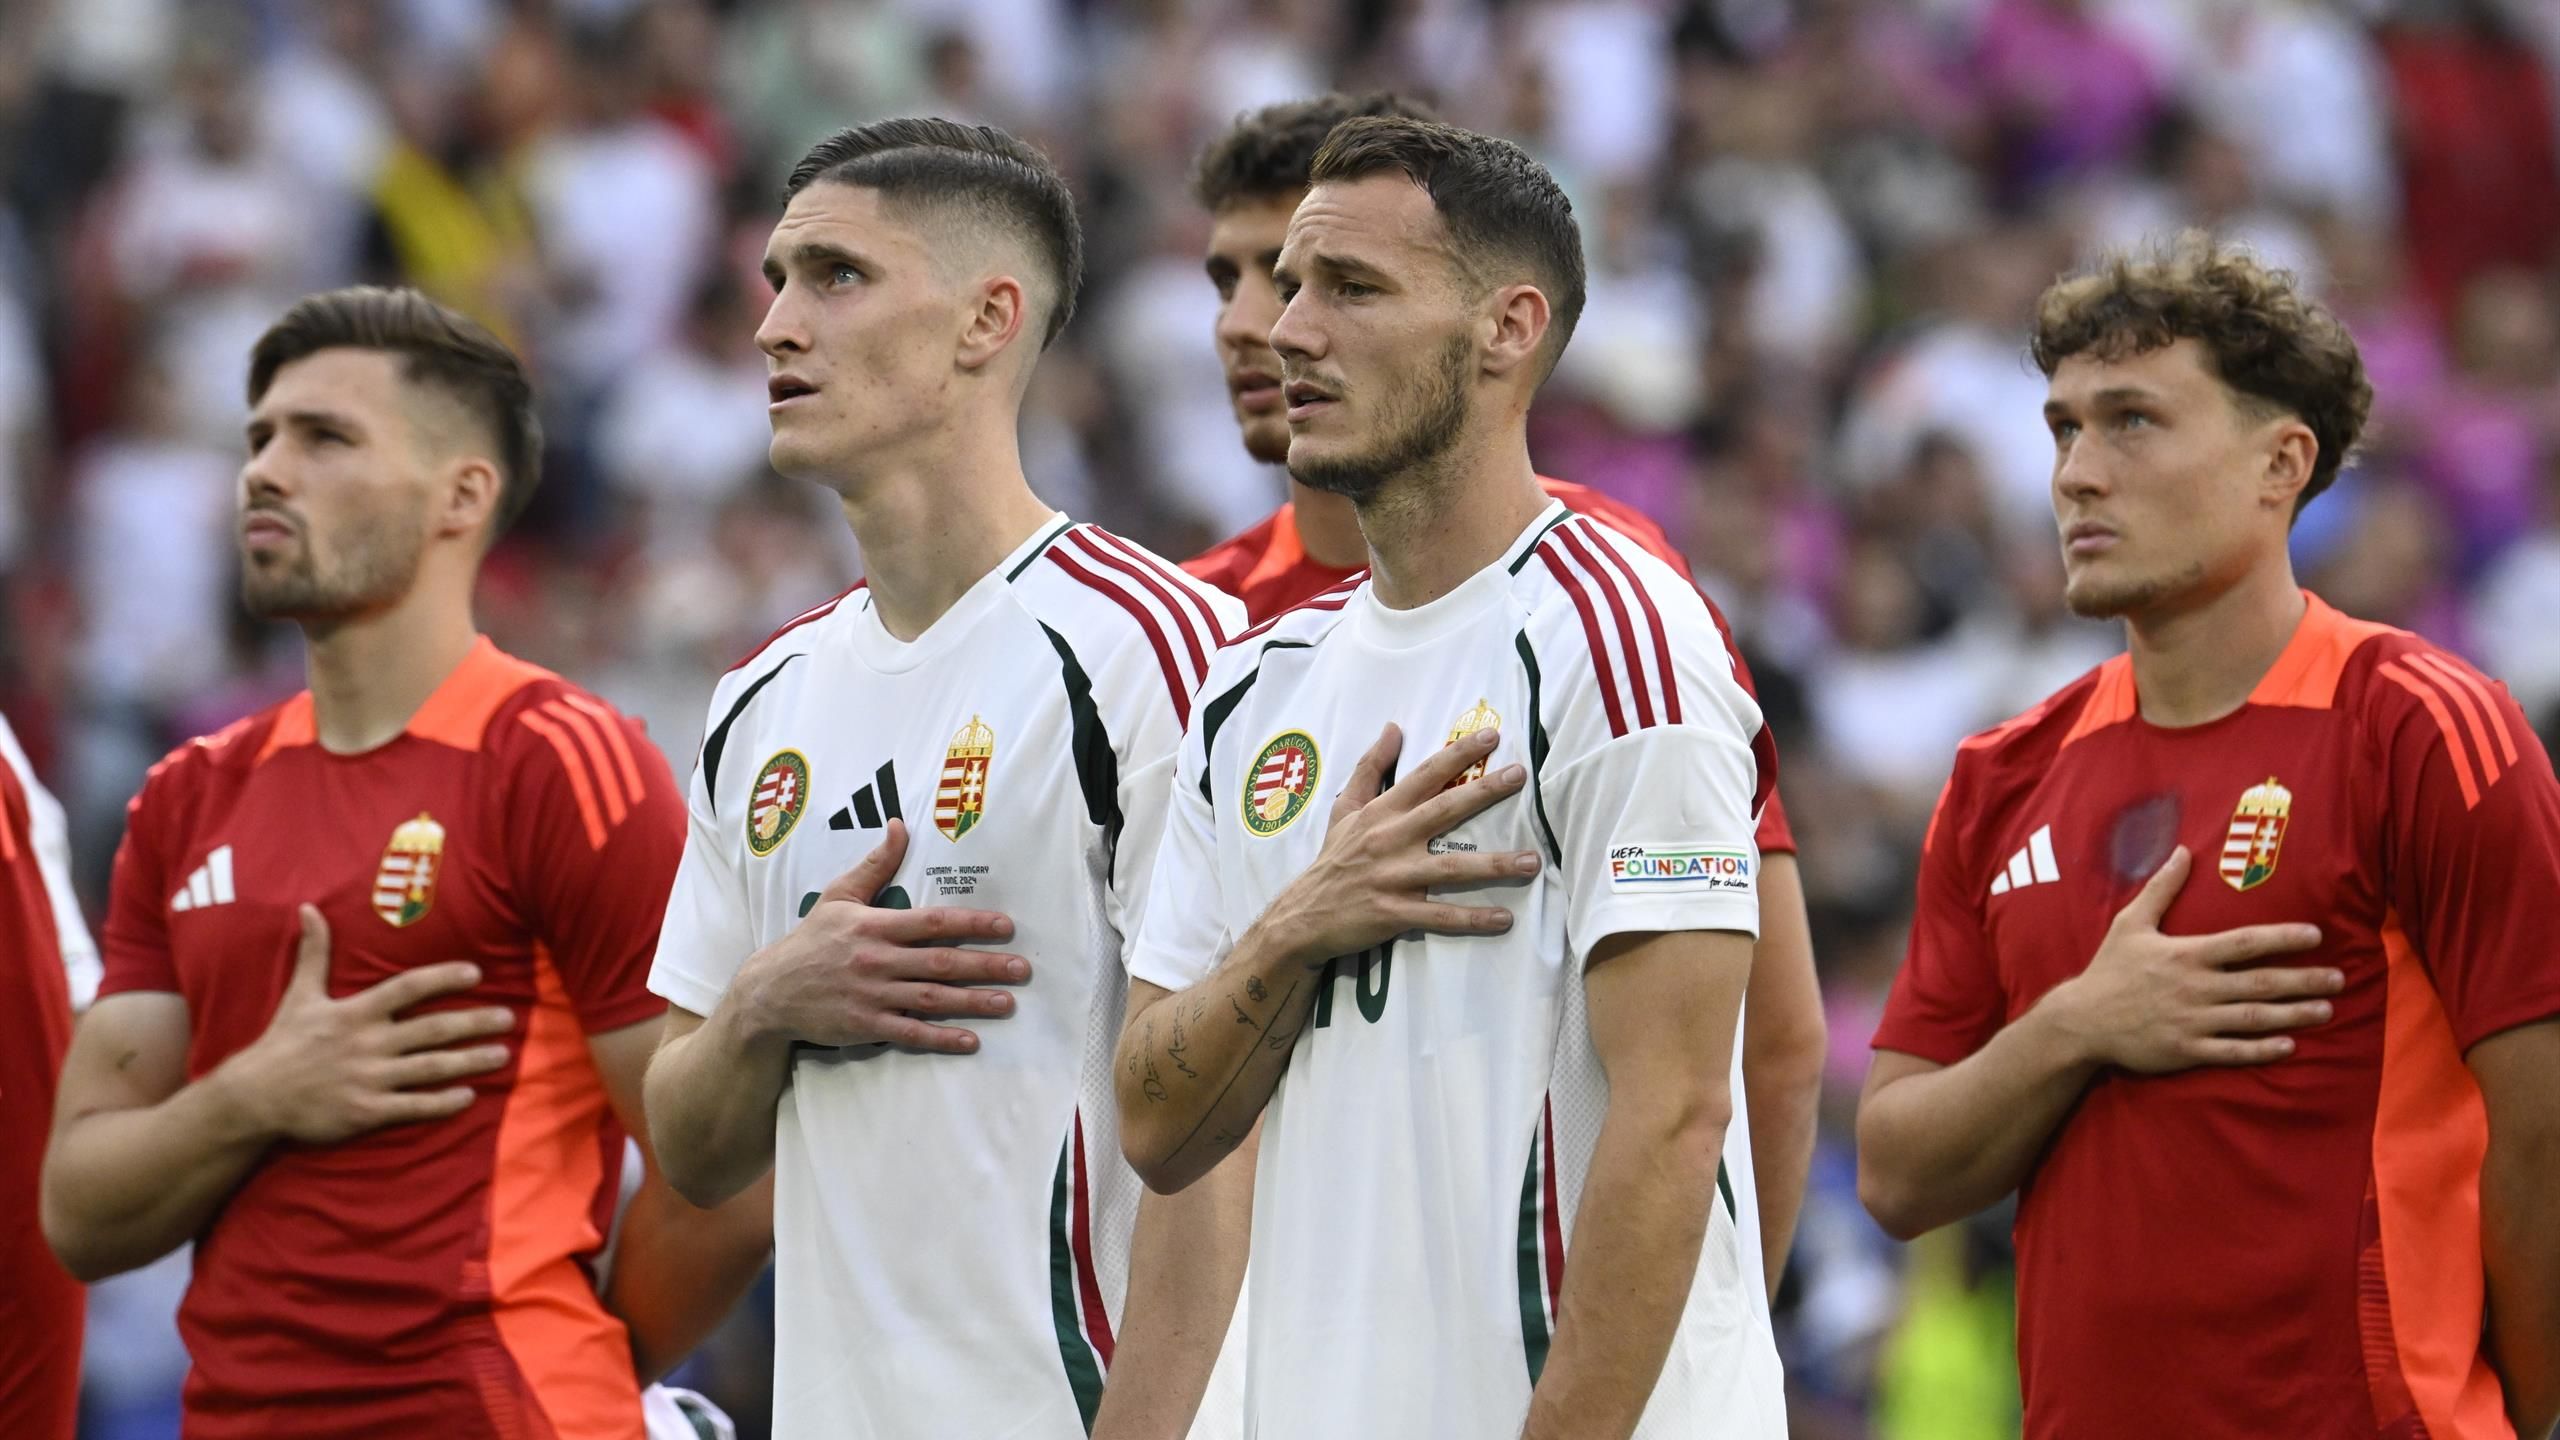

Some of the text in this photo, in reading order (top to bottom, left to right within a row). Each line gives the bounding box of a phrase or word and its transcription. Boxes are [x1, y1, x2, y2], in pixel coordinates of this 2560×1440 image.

[1261, 820, 1281, 831] 1901
[1447, 842, 1478, 852] HUNGARY
[1611, 847, 1644, 859] UEFA
[926, 866, 952, 876] GERMANY
[958, 865, 989, 874] HUNGARY
[943, 876, 958, 885] JUNE
[959, 876, 977, 885] 2024
[1709, 878, 1749, 889] for children
[940, 886, 974, 895] STUTTGART
